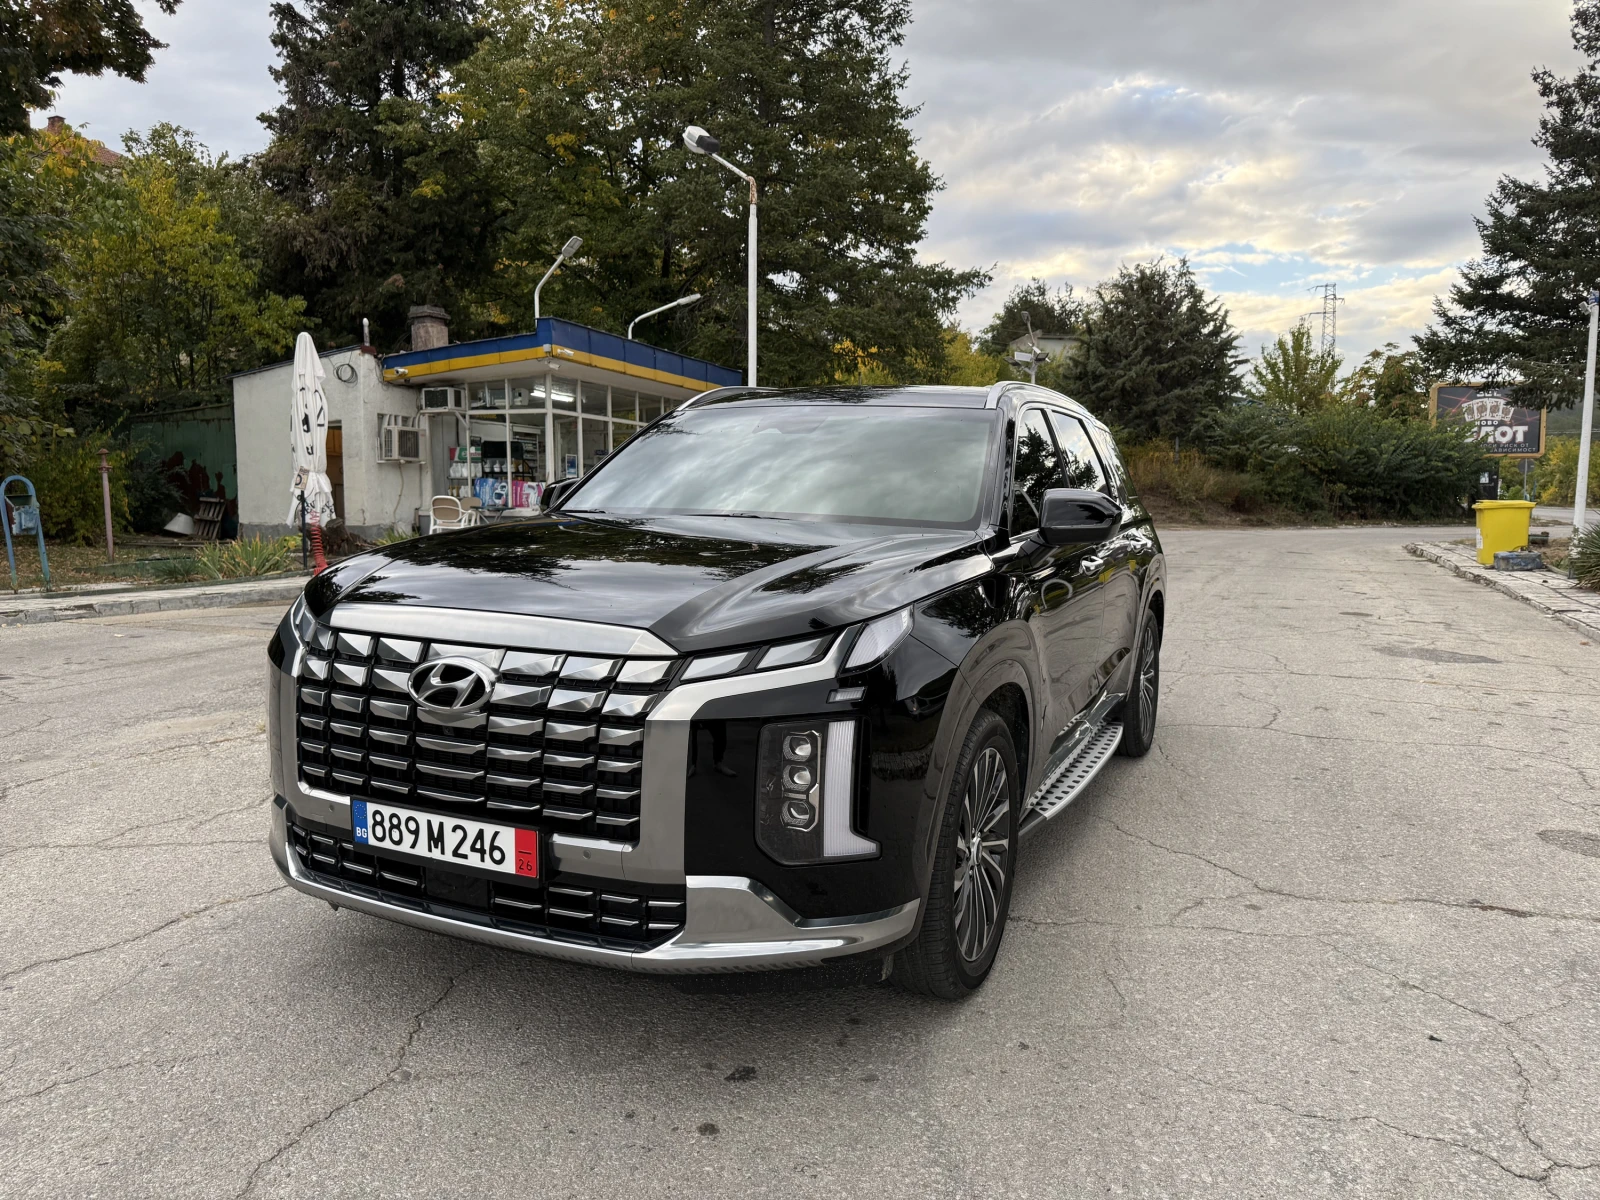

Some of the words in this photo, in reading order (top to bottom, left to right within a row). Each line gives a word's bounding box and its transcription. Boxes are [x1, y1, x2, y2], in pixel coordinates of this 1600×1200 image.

[356, 826, 367, 838] BG
[371, 809, 420, 849] 889
[451, 824, 506, 865] 246
[518, 858, 533, 872] 26
